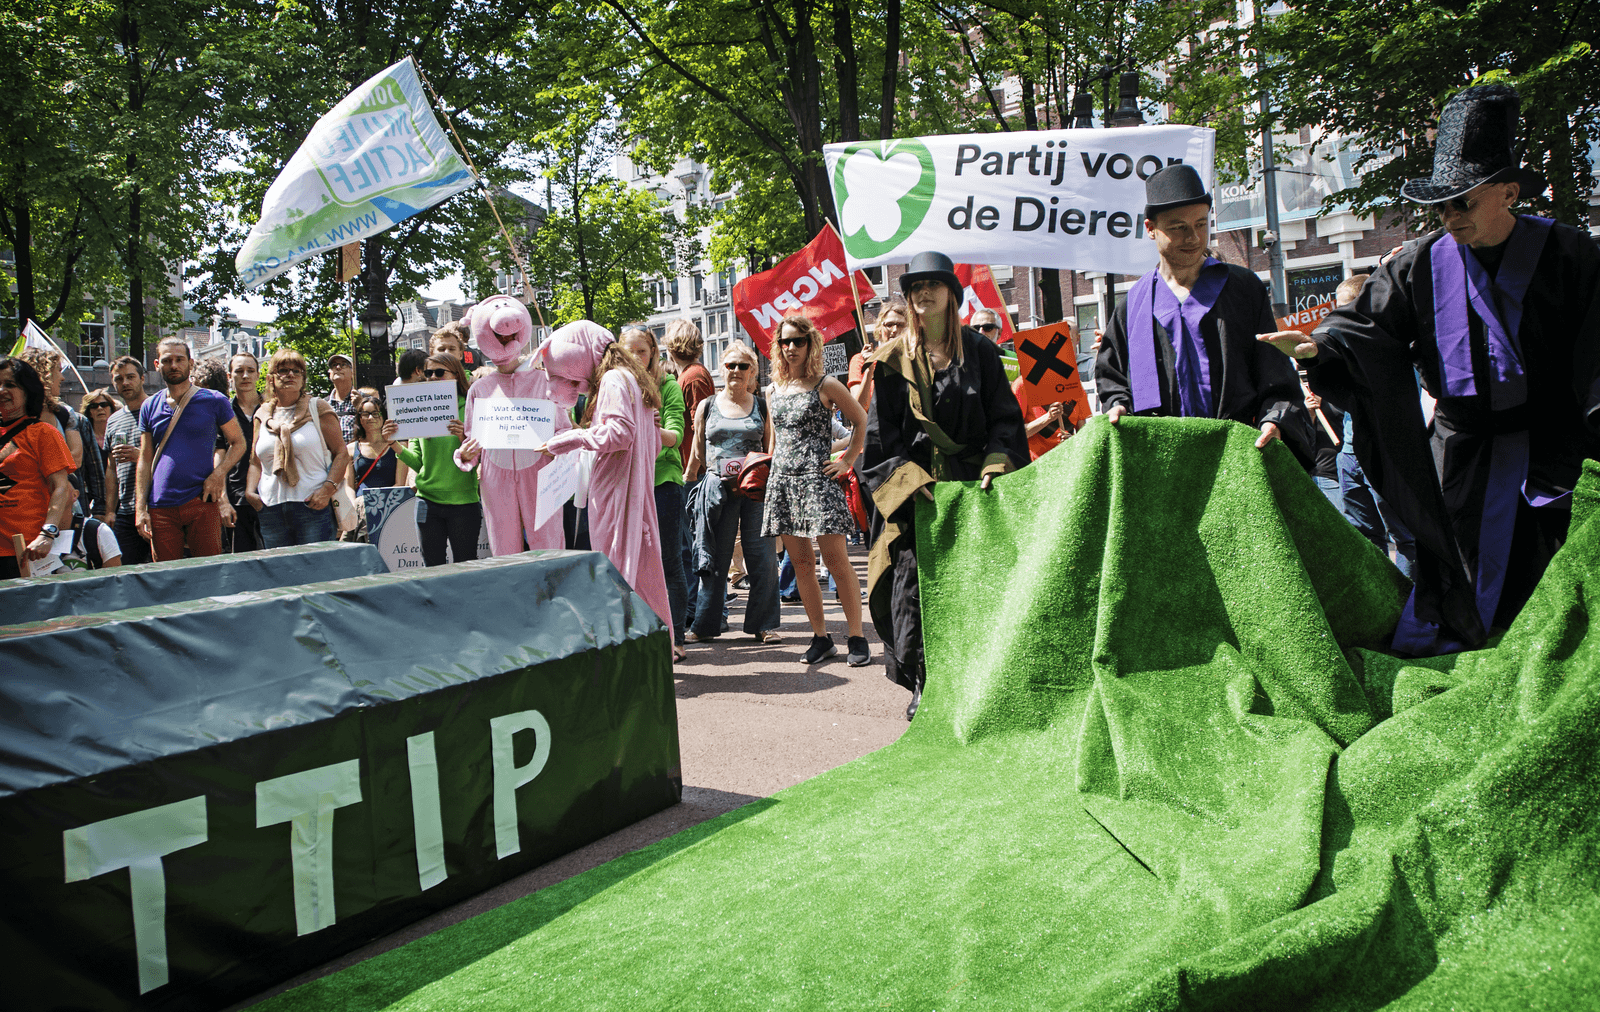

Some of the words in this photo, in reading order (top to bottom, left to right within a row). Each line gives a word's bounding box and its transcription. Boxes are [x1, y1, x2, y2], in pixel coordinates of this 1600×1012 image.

[955, 140, 1068, 186] Partij
[947, 195, 1000, 230] de
[1294, 275, 1338, 285] PRIMARK
[1295, 292, 1337, 313] KOM
[415, 394, 433, 403] CETA
[434, 393, 453, 401] laten
[395, 405, 432, 416] geldwolven
[522, 405, 540, 413] boer
[392, 415, 428, 425] democratie
[430, 414, 455, 423] opeten
[530, 415, 551, 423] trade
[499, 423, 509, 432] hij
[392, 543, 408, 555] Als
[398, 558, 418, 569] Dan
[63, 709, 552, 996] TTIP
